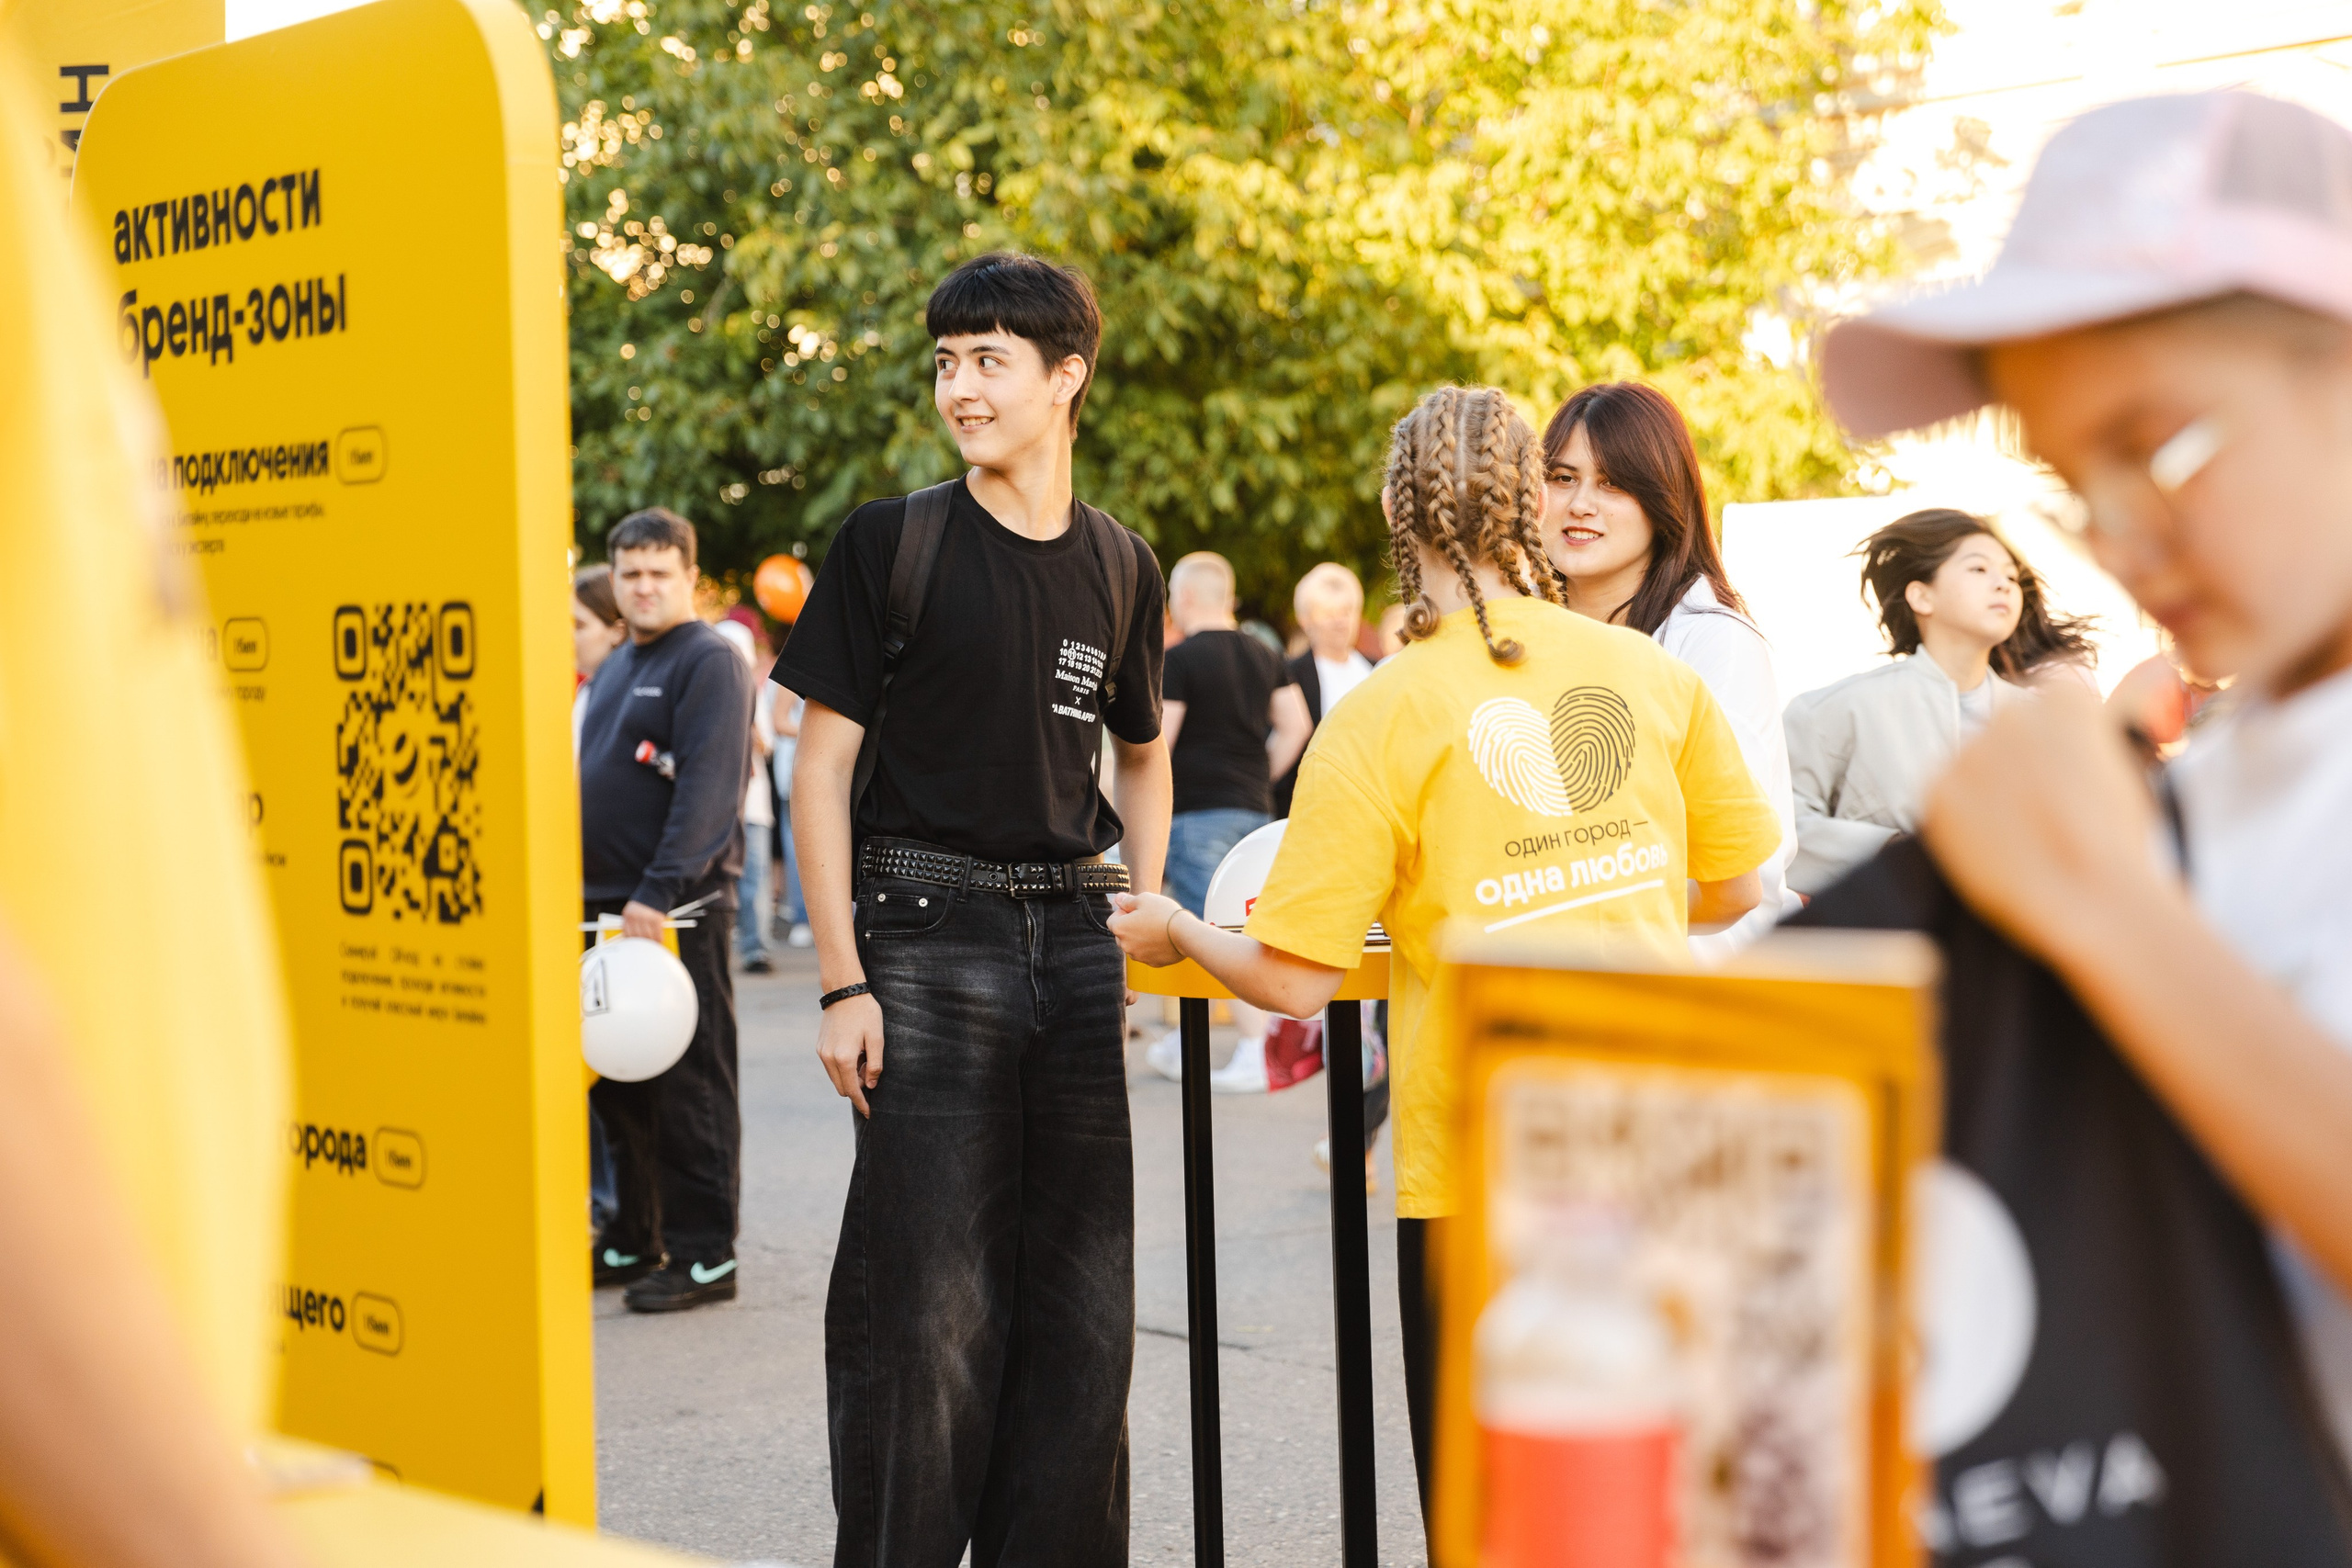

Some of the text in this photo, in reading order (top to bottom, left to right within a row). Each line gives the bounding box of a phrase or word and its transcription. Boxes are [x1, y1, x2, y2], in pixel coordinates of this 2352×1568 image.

[113, 167, 322, 265] активности
[117, 273, 346, 379] бренд-зоны
[173, 440, 329, 496] подключения
[1063, 638, 1069, 647] 0
[1058, 657, 1067, 665] 17
[1068, 660, 1075, 668] 18
[1075, 661, 1082, 670] 19
[1082, 663, 1091, 672] 20
[1059, 648, 1068, 657] 10
[1076, 652, 1084, 660] 12
[1084, 654, 1091, 663] 13
[1055, 669, 1080, 684] Maison
[1072, 684, 1090, 695] PARIS
[1505, 833, 1561, 858] один
[1475, 841, 1668, 908] одна любовь
[284, 1120, 366, 1177] орода
